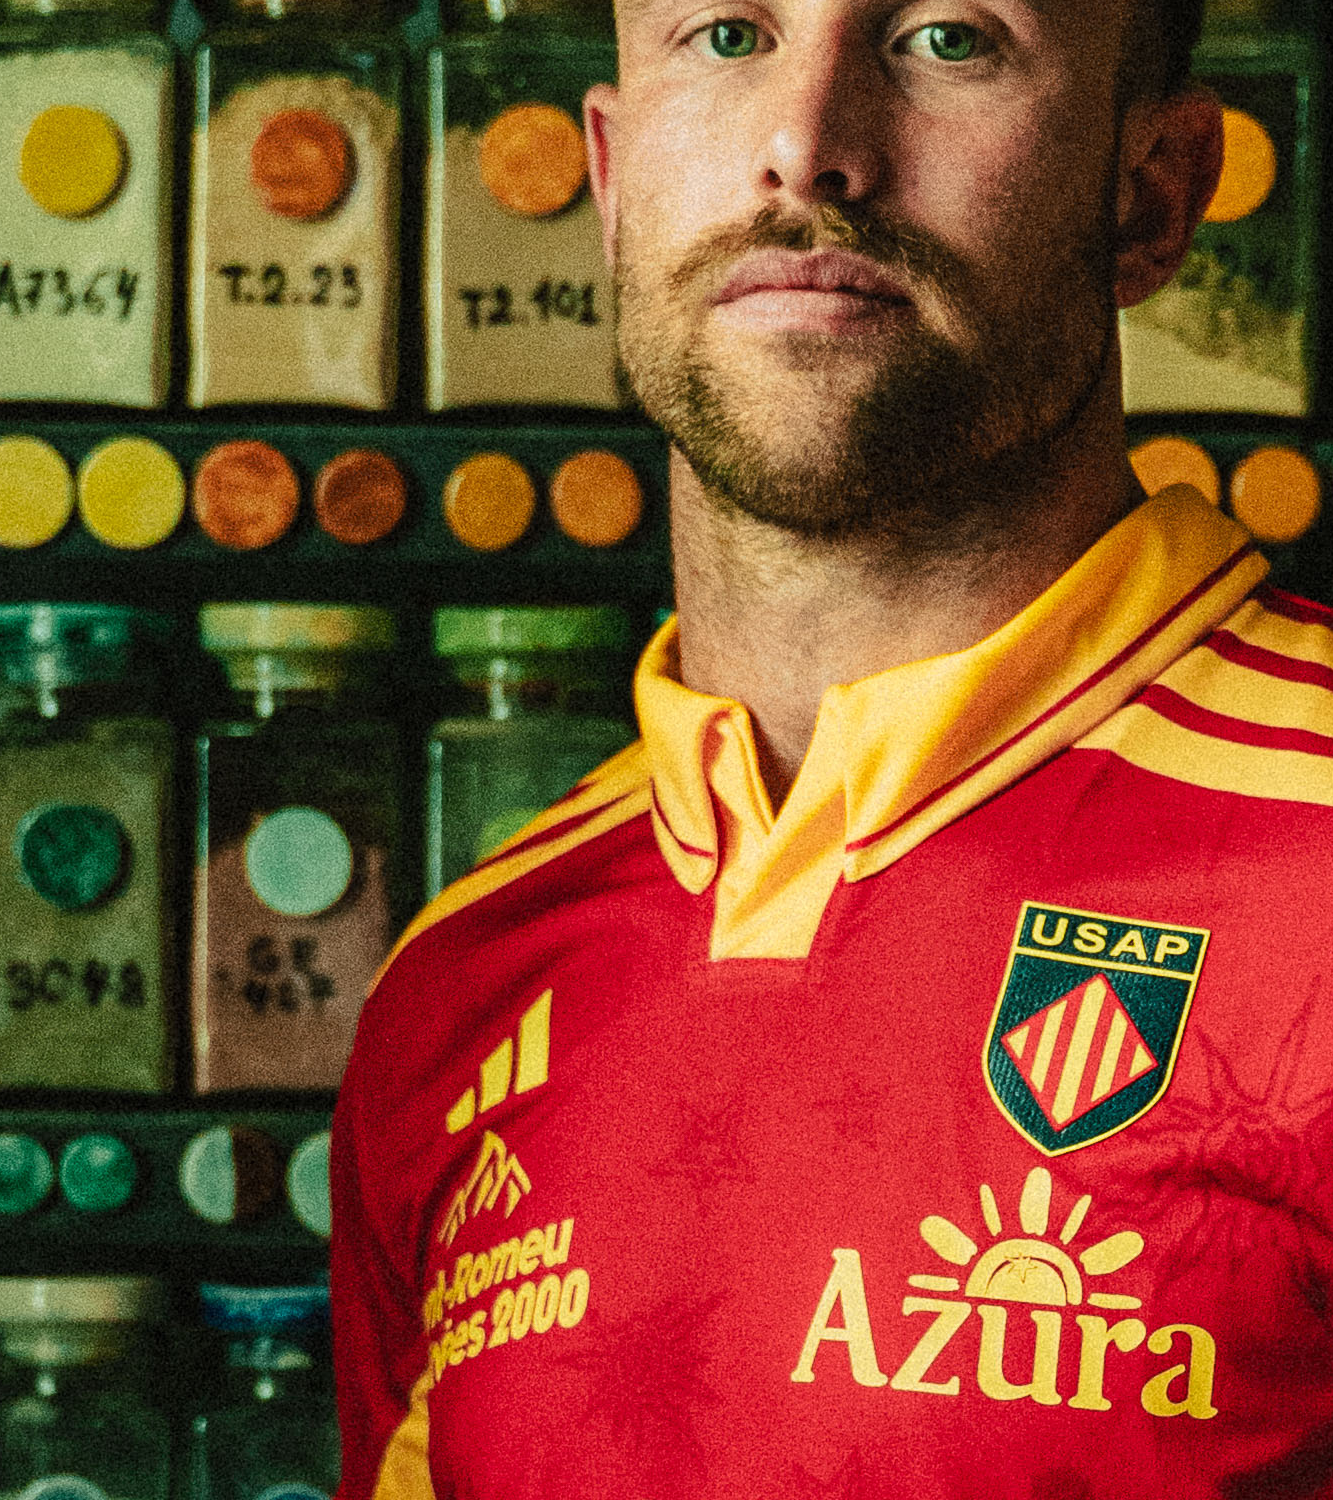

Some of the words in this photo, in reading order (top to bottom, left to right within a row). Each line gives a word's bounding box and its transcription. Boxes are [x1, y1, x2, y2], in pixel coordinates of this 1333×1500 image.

[1030, 912, 1191, 964] USAP
[488, 1266, 592, 1350] 2000
[790, 1247, 1220, 1420] Azura
